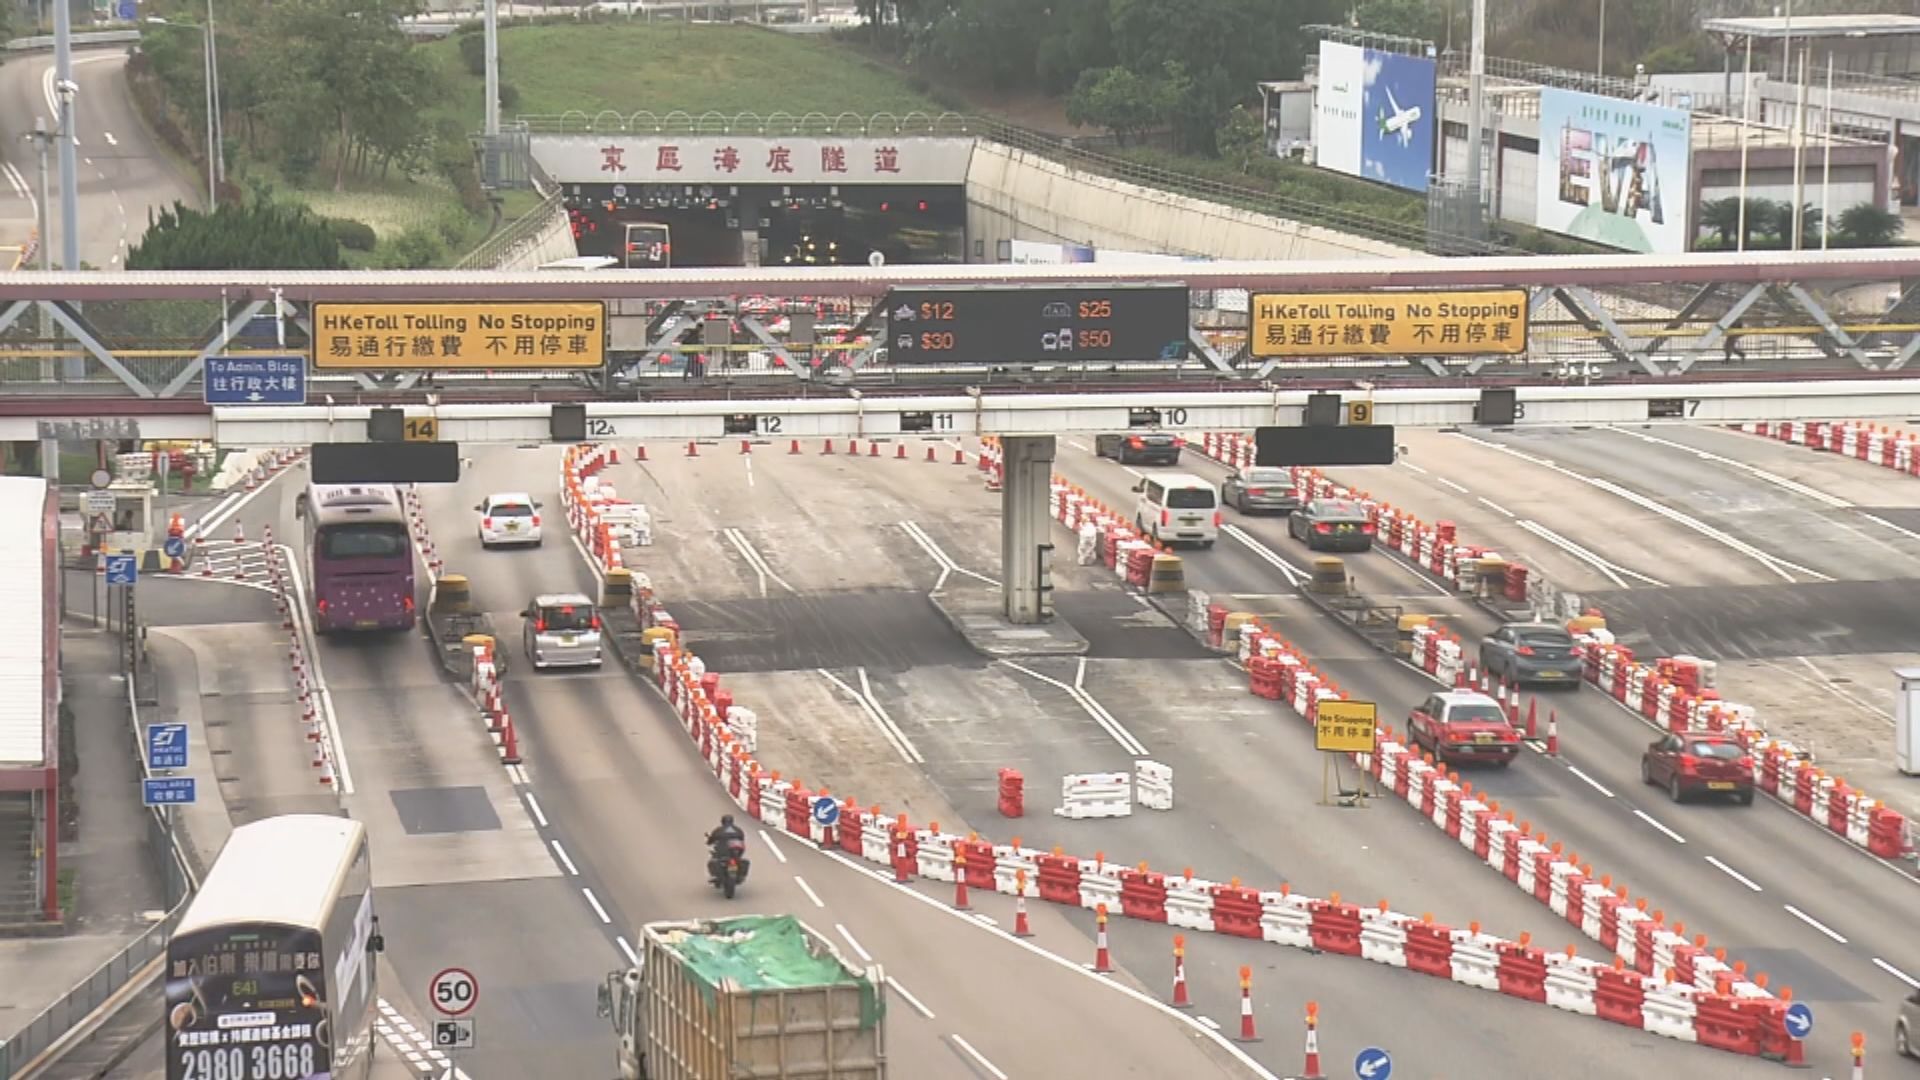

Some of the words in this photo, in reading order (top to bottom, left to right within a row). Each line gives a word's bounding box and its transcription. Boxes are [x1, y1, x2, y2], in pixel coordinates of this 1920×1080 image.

[600, 145, 902, 174] 東區海底隧道
[921, 302, 954, 319] $12
[1079, 301, 1111, 317] $25
[1261, 304, 1330, 319] HKeToll
[1337, 304, 1395, 321] Tolling
[1407, 304, 1431, 317] No
[1438, 302, 1519, 320] Stopping
[323, 315, 398, 330] HKeToll
[403, 315, 467, 333] Tolling
[479, 314, 505, 330] No
[511, 314, 596, 332] Stopping
[921, 332, 954, 350] $30
[1079, 330, 1112, 347] $50
[1266, 324, 1391, 345] 易通行繳費
[1413, 323, 1512, 344] 不用停車
[330, 335, 463, 357] 易通行繳費
[485, 335, 589, 356] 不用停車
[209, 361, 225, 372] To
[1165, 408, 1187, 425] 10
[1354, 404, 1367, 421] 9
[1687, 400, 1701, 417] 7
[405, 420, 434, 437] 14
[587, 420, 616, 436] 12A
[761, 416, 782, 433] 12
[937, 413, 953, 429] 11
[437, 980, 472, 1003] 50
[182, 1048, 244, 1080] 2980
[252, 1043, 314, 1080] 3668
